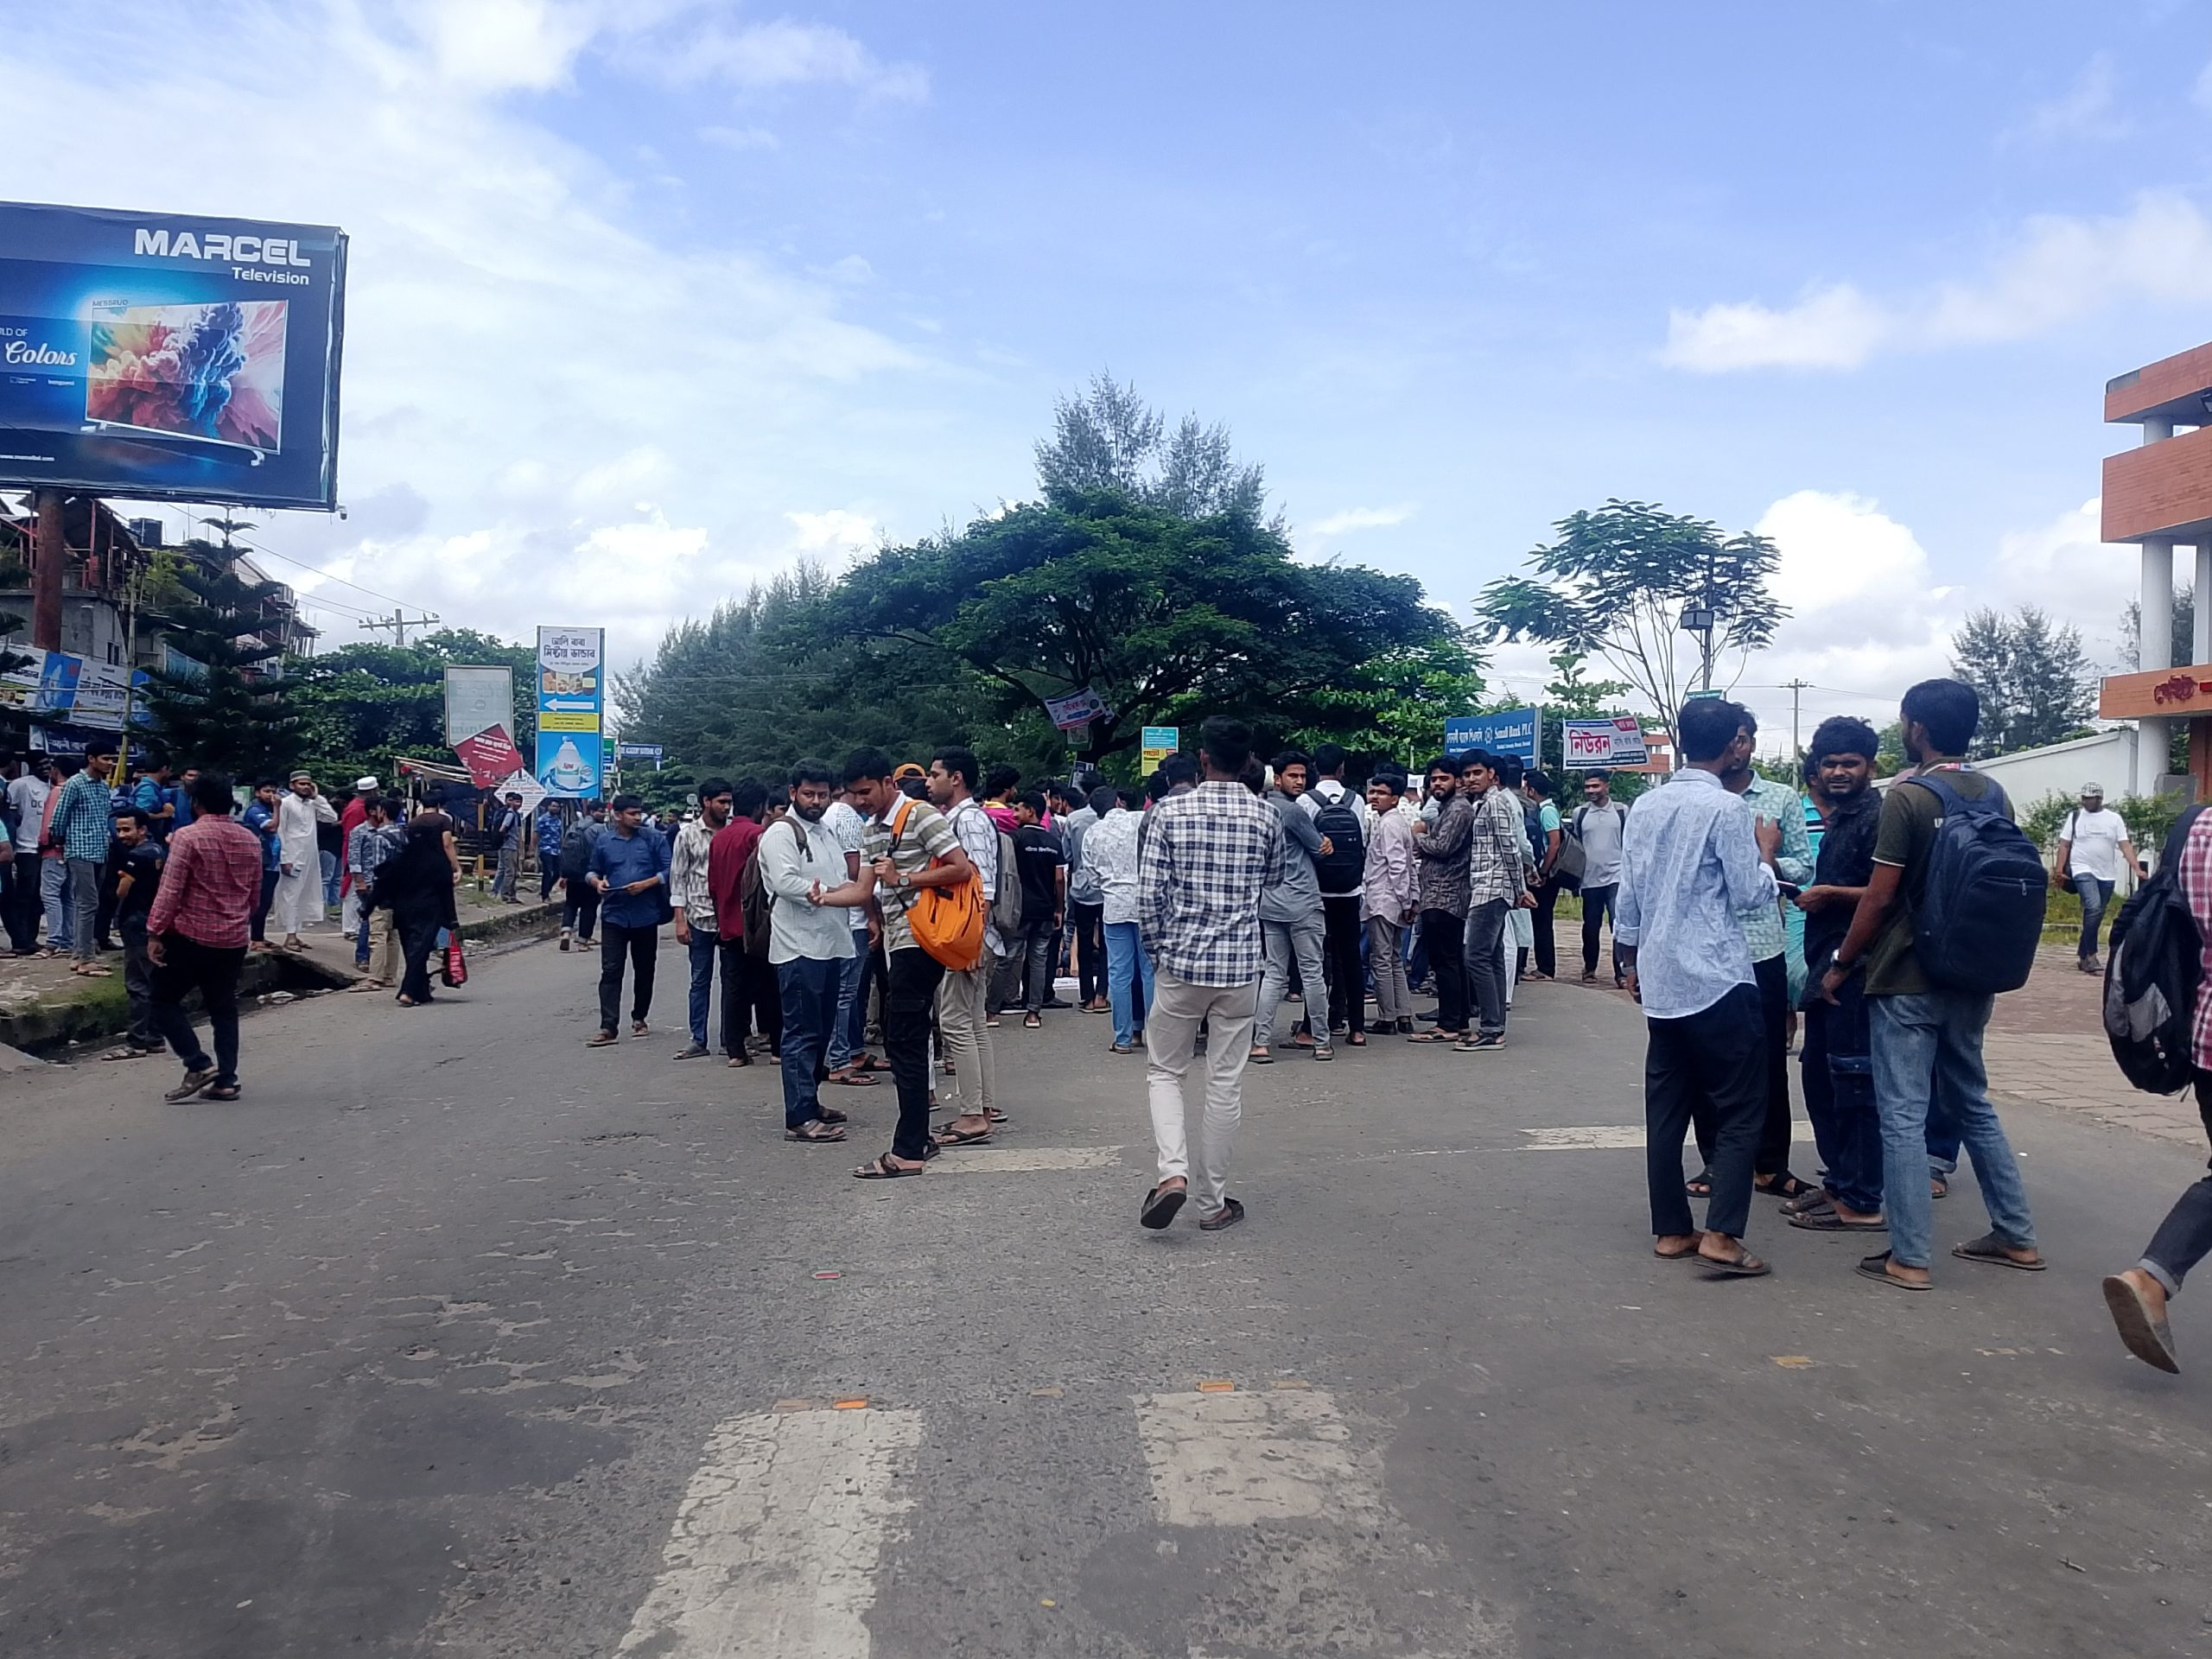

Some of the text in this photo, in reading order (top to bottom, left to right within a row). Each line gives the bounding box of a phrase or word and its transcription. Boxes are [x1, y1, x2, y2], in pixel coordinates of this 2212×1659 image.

[135, 228, 311, 267] MARCEL
[232, 266, 309, 286] Television
[16, 327, 29, 336] OF
[5, 340, 78, 365] Colors
[1522, 721, 1534, 736] PLC
[1569, 728, 1611, 756] নিউরন
